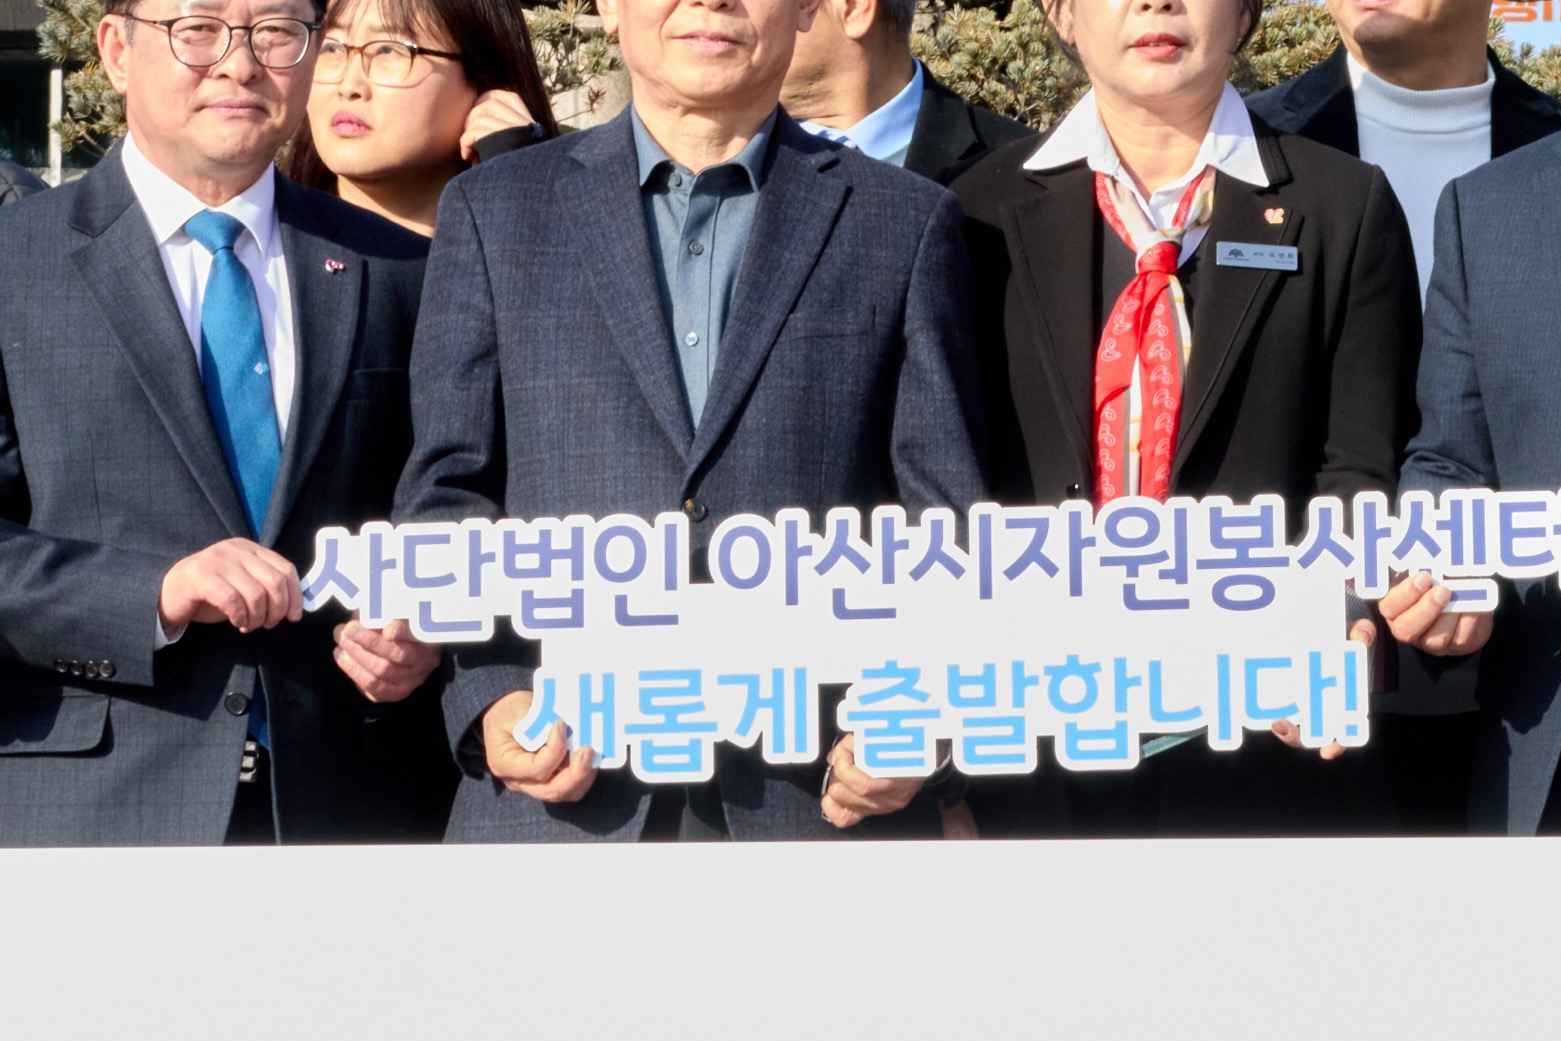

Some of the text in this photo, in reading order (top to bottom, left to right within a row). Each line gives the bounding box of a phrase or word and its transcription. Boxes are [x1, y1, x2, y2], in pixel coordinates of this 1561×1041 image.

[302, 523, 680, 634] 사단법인
[524, 648, 1362, 776] 새롭게 출발합니다!
